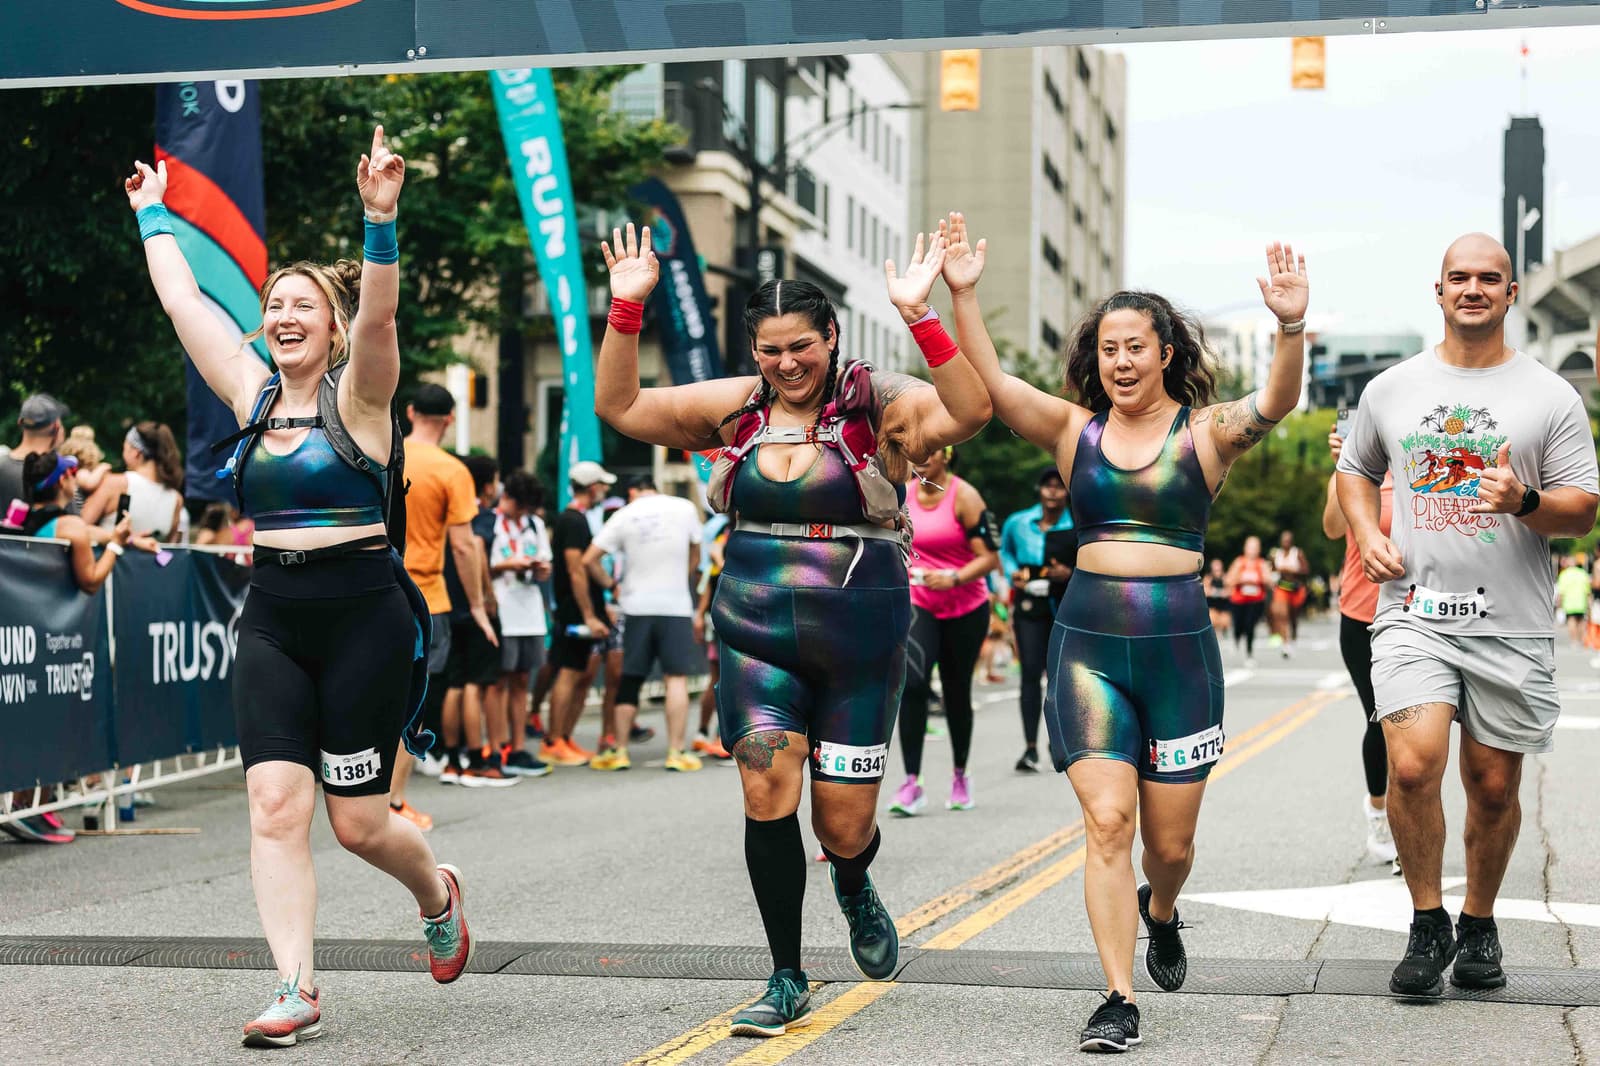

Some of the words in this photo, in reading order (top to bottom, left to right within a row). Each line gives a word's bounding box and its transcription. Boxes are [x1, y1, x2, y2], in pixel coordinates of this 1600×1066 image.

[520, 136, 566, 259] RUN
[1398, 431, 1441, 453] Welcome
[1442, 435, 1457, 450] to
[1456, 433, 1477, 451] the
[1423, 599, 1434, 614] G
[1438, 601, 1477, 616] 9151
[0, 673, 25, 704] WN
[45, 663, 83, 695] TRUIST
[834, 755, 846, 772] G
[1174, 749, 1186, 766] G
[323, 762, 331, 779] G
[333, 759, 373, 781] 1381
